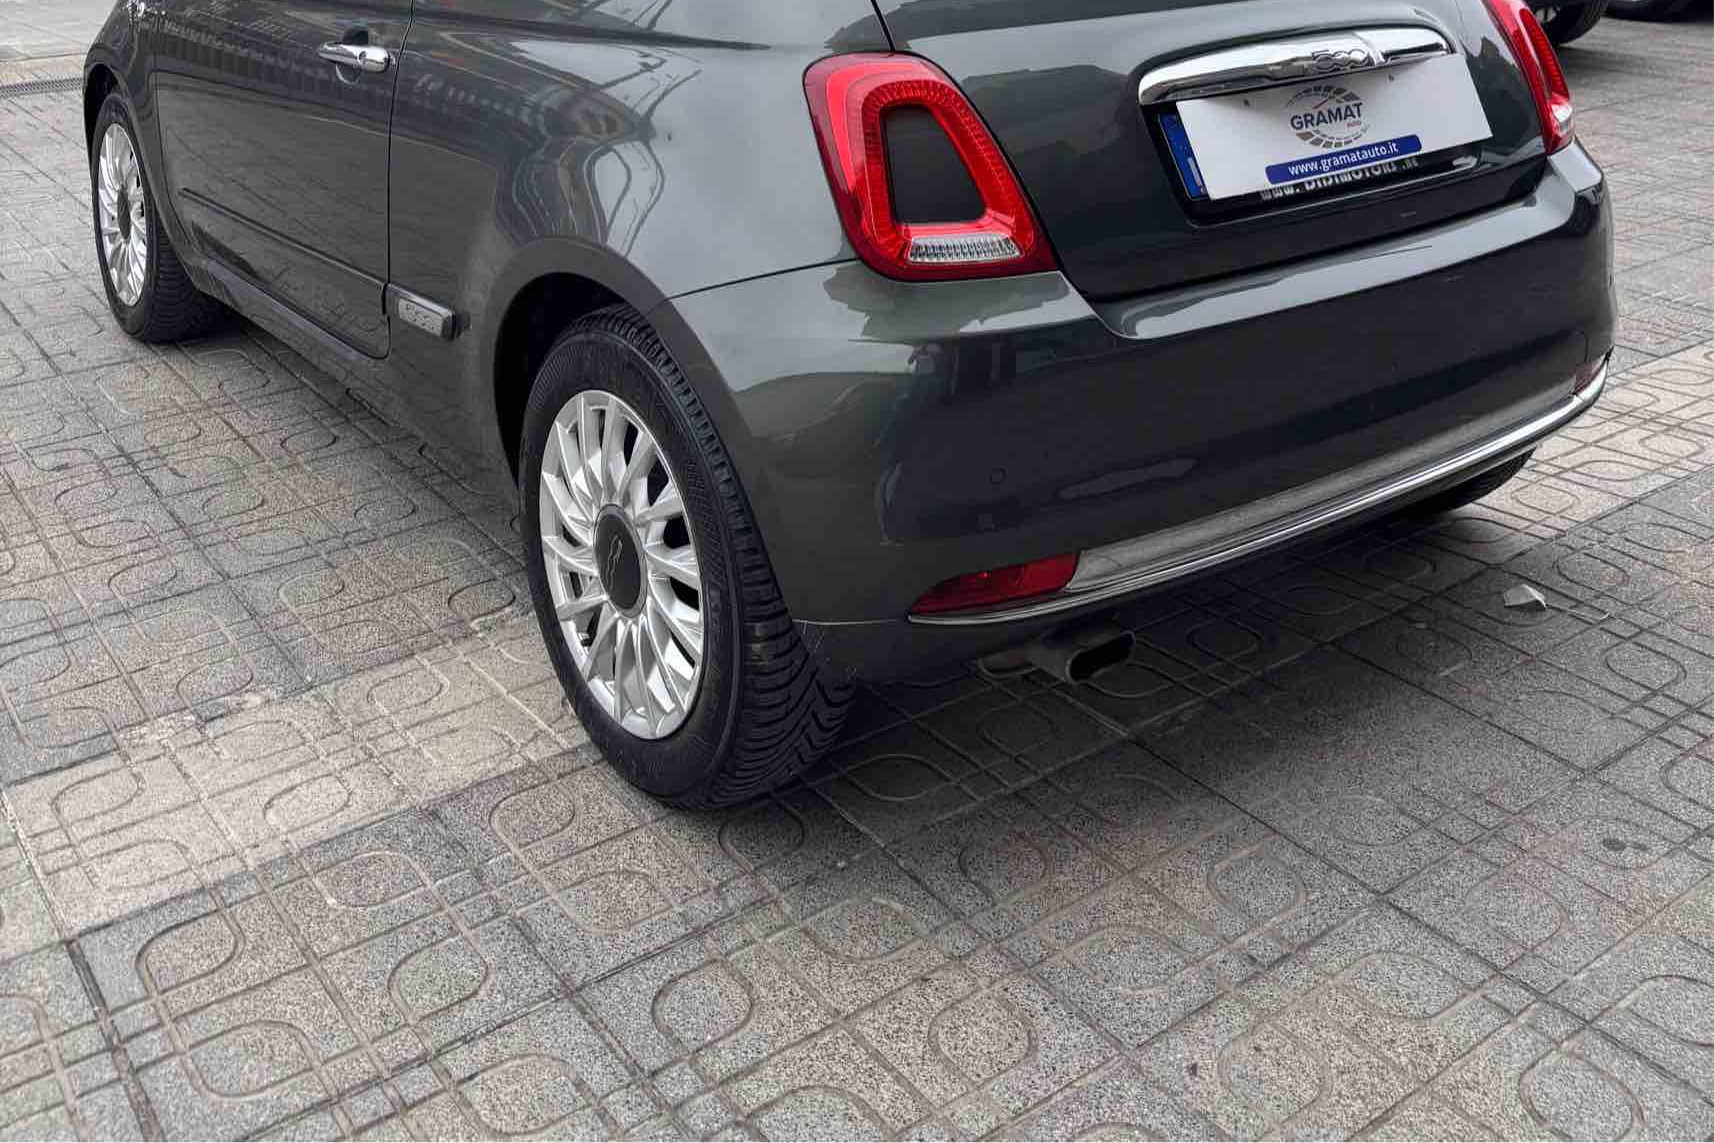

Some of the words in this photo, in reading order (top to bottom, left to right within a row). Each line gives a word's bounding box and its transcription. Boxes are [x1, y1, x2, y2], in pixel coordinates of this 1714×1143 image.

[1311, 48, 1370, 73] 500
[1290, 102, 1363, 130] GRAMAT
[1288, 141, 1399, 176] www.gramatauto.it
